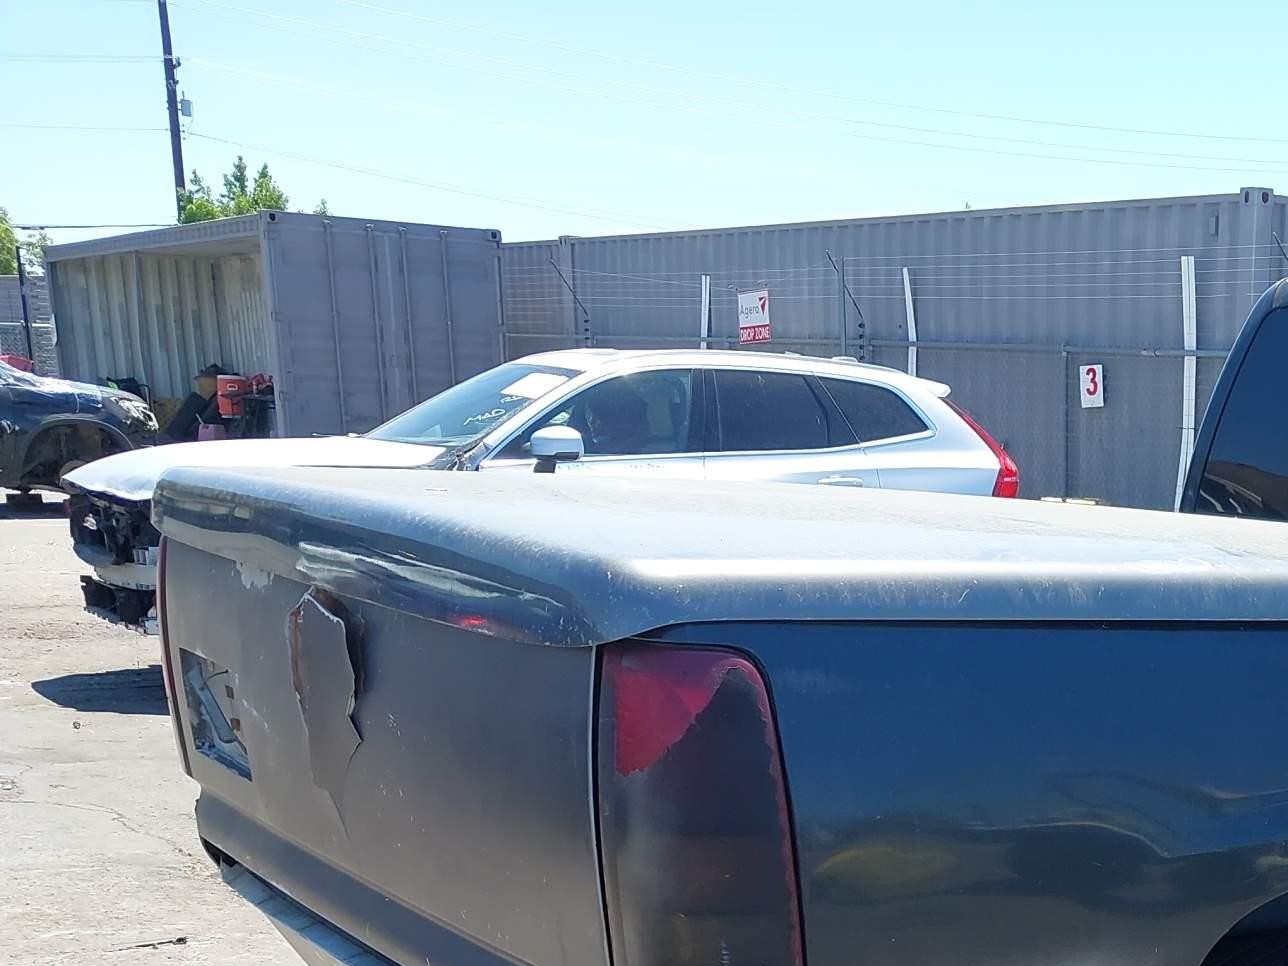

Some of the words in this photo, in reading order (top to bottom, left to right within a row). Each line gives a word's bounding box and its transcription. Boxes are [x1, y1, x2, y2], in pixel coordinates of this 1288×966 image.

[740, 304, 760, 319] Agero
[740, 328, 755, 341] DROP
[755, 326, 770, 340] ZONE
[1085, 367, 1098, 396] 3
